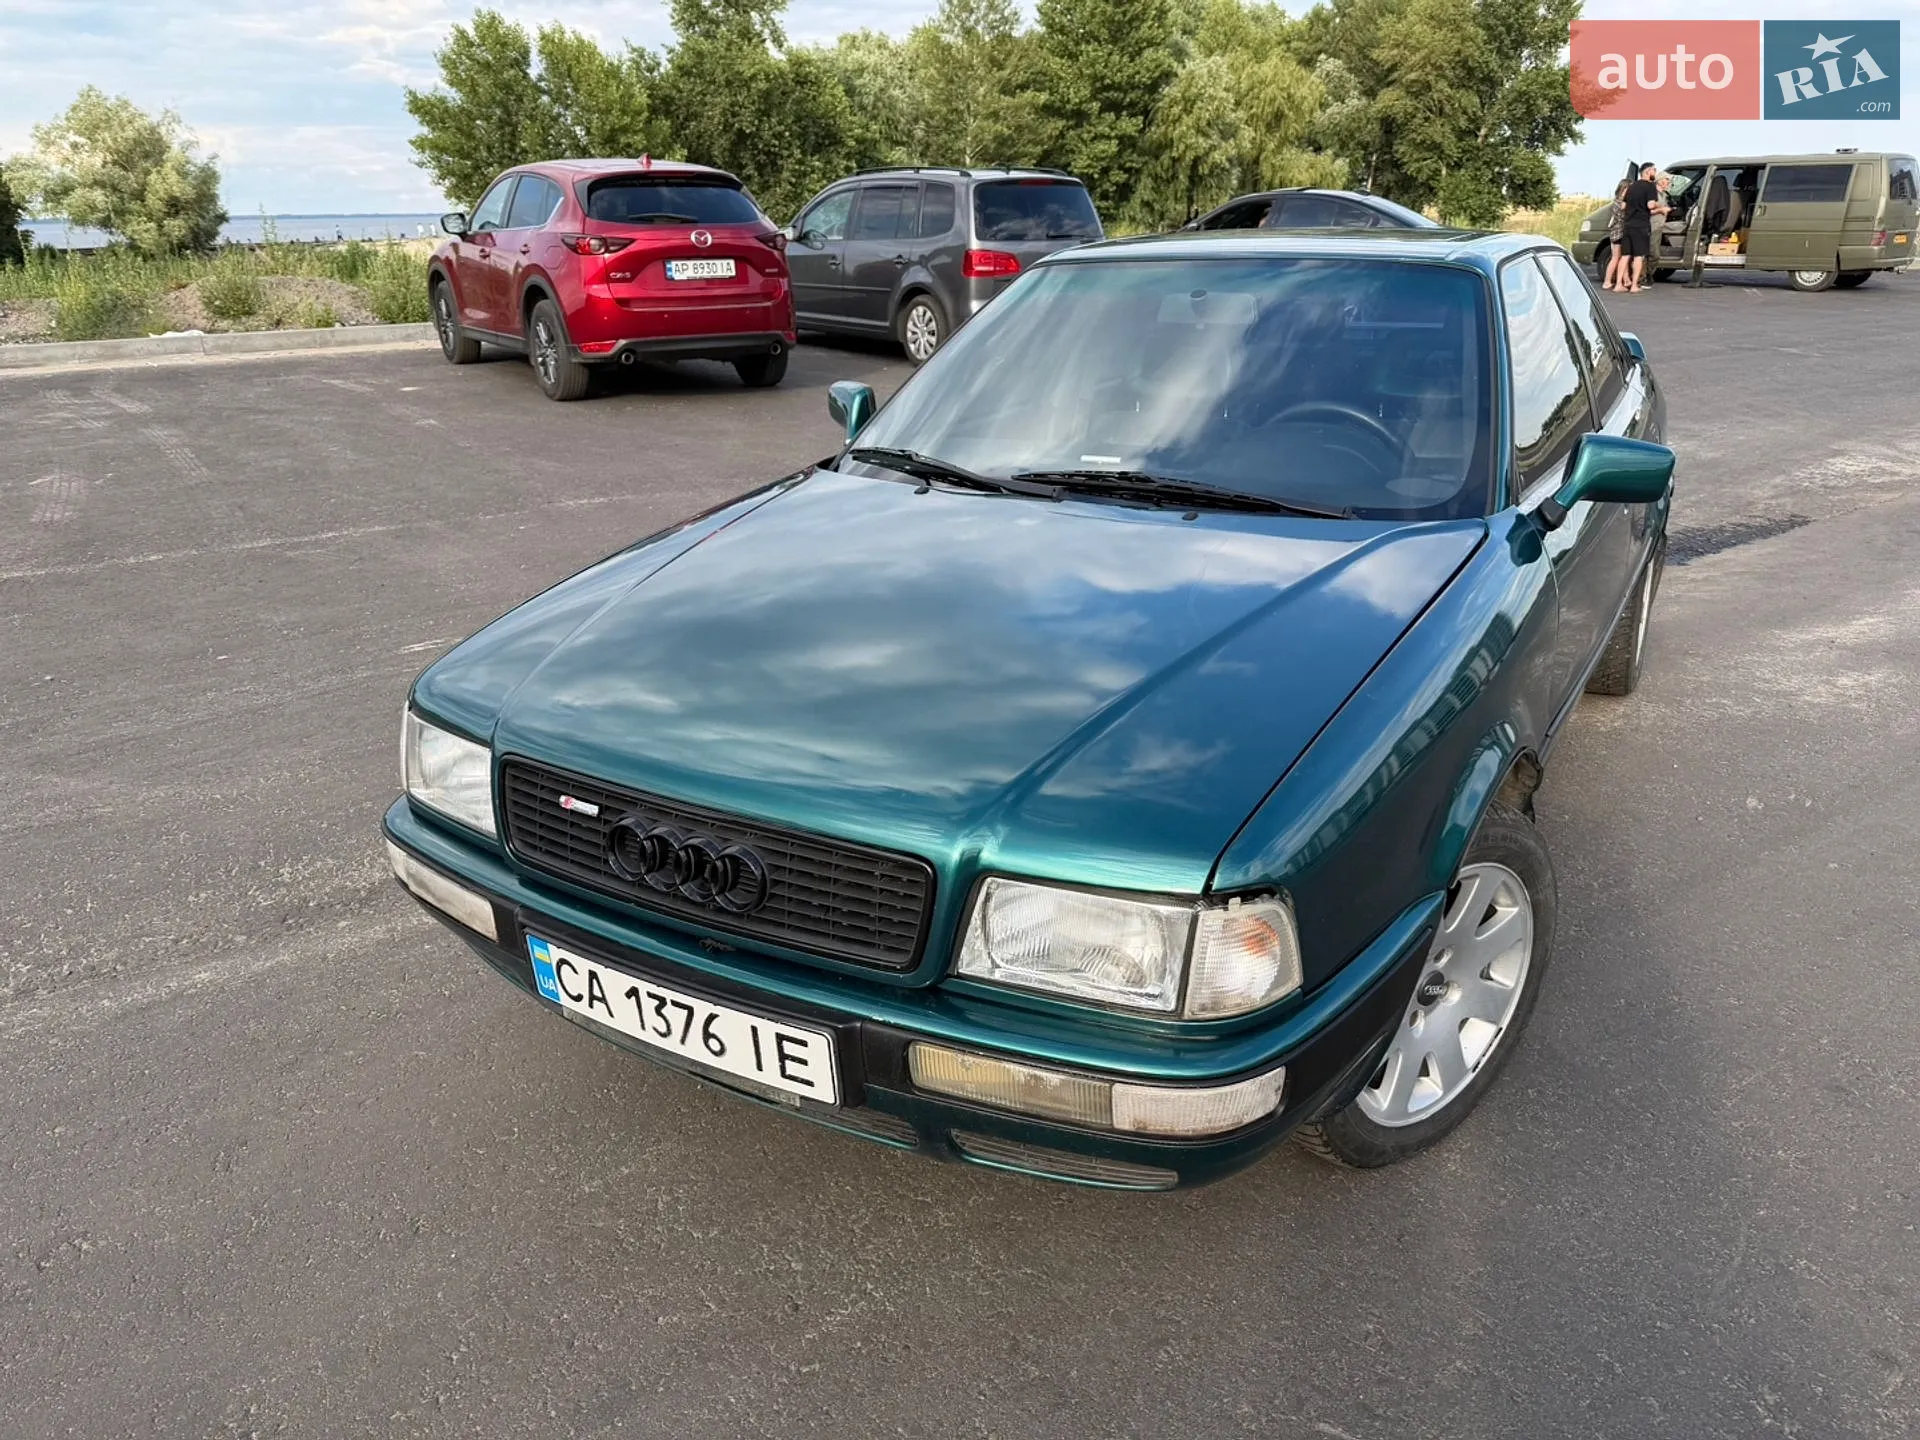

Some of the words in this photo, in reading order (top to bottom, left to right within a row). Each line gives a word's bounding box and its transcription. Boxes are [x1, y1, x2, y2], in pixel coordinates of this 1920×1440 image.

[692, 262, 718, 274] 8930
[539, 974, 558, 993] UA
[555, 957, 614, 1019] CA
[624, 985, 728, 1058] 1376
[750, 1024, 815, 1087] IE
